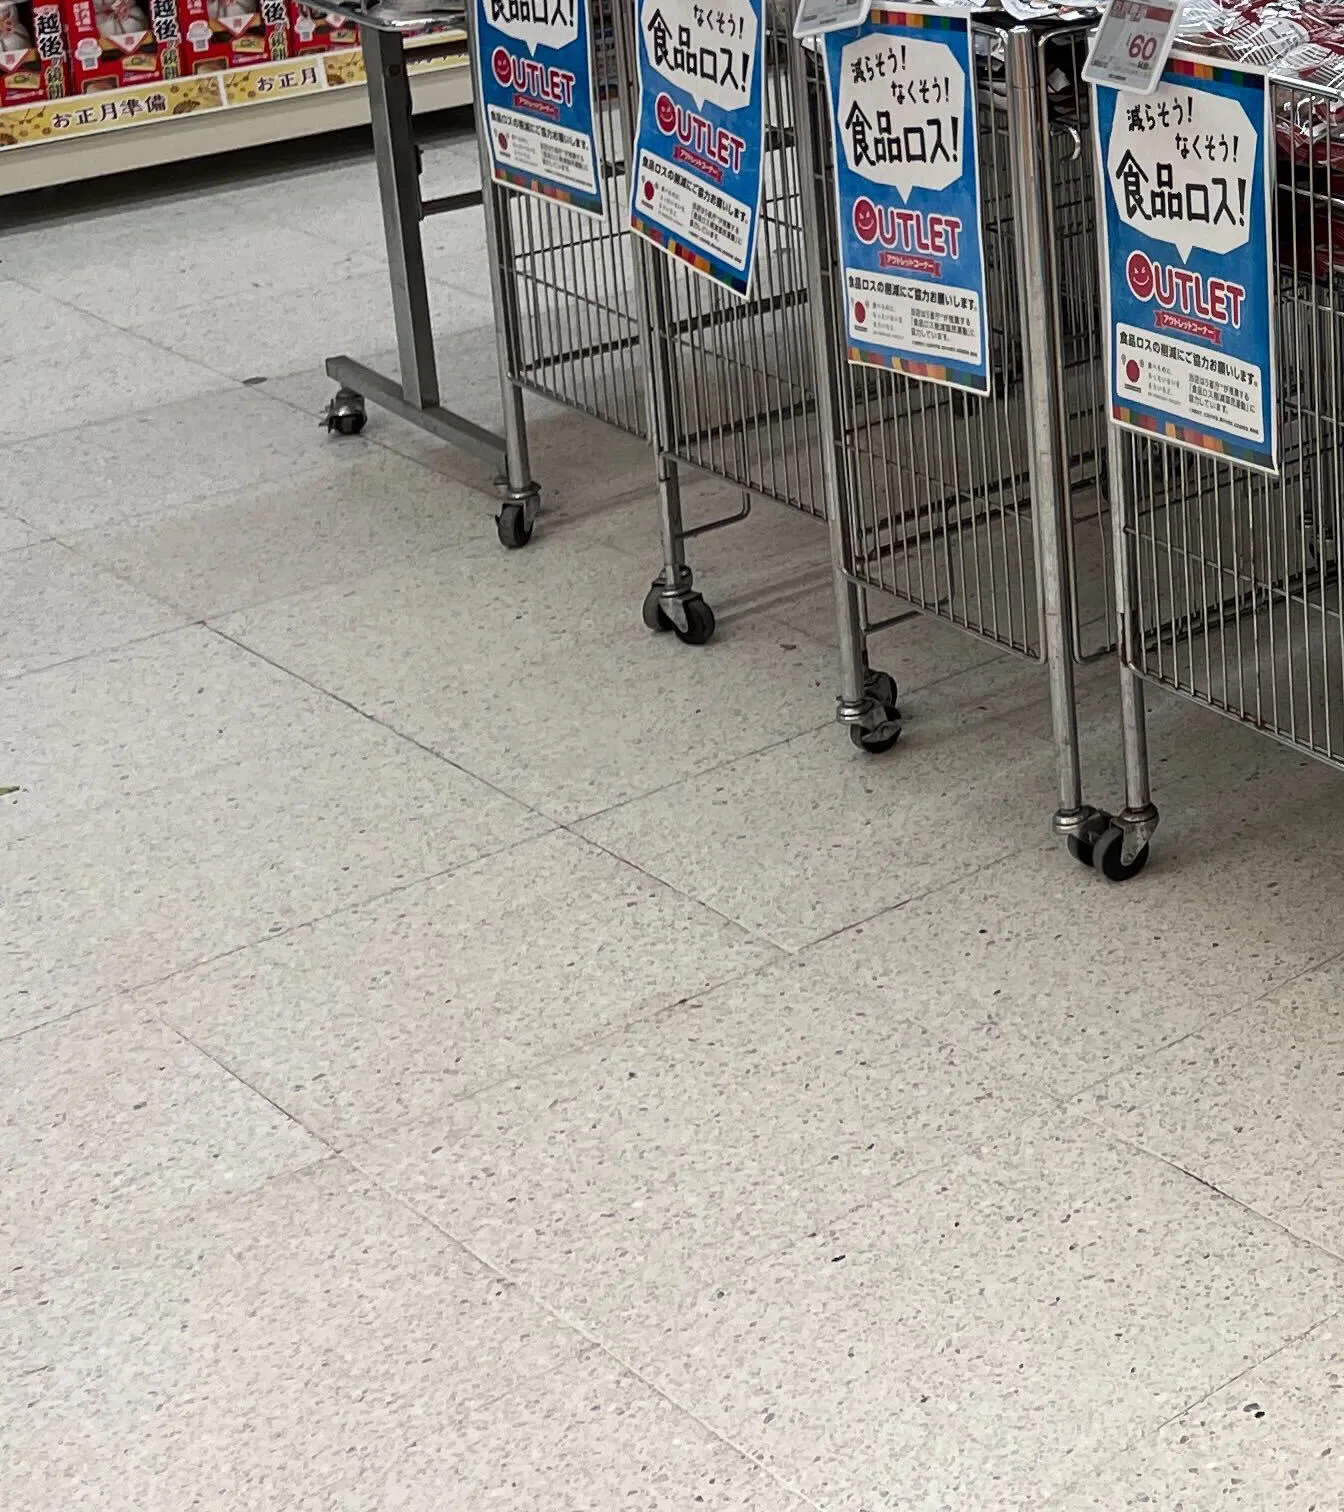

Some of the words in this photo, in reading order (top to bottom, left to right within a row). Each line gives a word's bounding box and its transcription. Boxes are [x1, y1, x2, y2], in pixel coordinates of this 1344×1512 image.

[693, 4, 745, 39] なくそう!
[647, 8, 750, 92] 食品ロス!
[850, 44, 907, 85] 減らそう!
[1128, 34, 1158, 62] 60
[491, 47, 576, 108] OUTLET
[891, 76, 950, 106] なくそう!
[52, 93, 167, 130] お正月準備
[654, 92, 746, 174] OUTLET
[845, 100, 960, 168] 食品ロス!
[1127, 96, 1194, 133] 減らそう!
[1175, 132, 1239, 164] なくそう!
[1115, 149, 1246, 228] 食品ロス!
[852, 195, 964, 261] OUTLET
[1125, 249, 1246, 329] OUTLET
